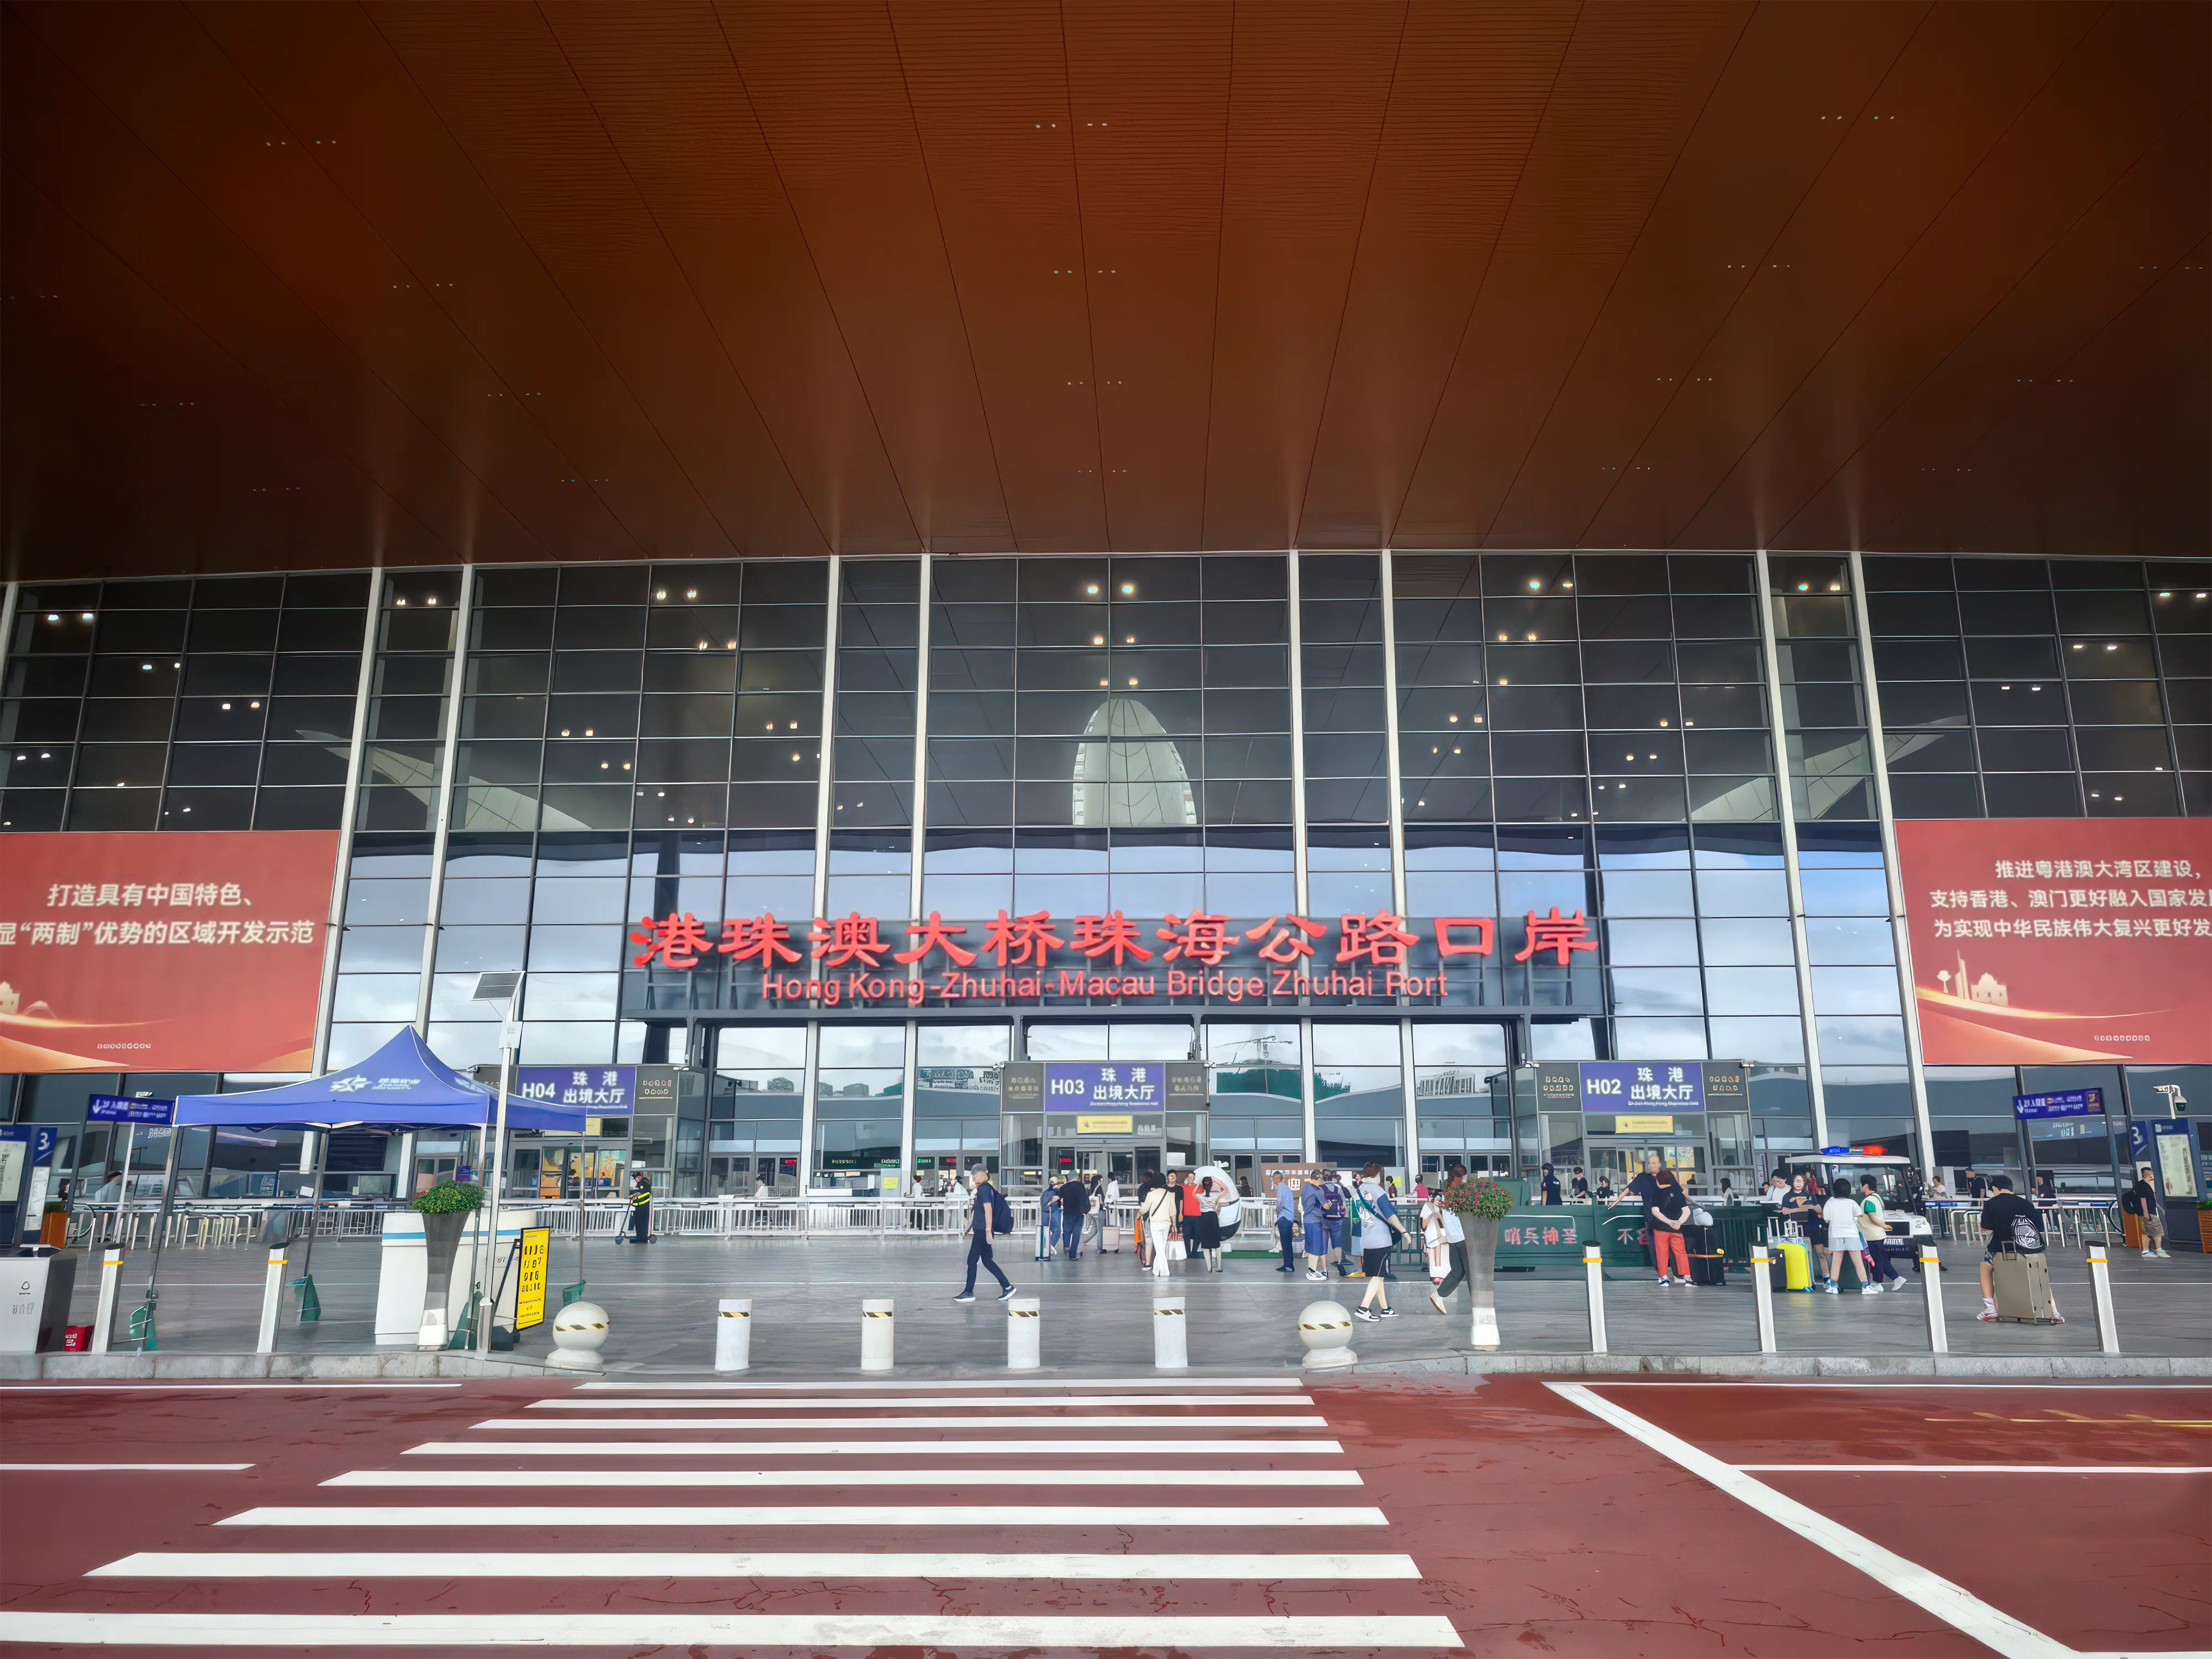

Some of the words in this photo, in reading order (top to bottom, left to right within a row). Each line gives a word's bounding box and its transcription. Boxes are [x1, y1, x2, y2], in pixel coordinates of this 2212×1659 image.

[48, 883, 252, 907] 打造具有中国特色、
[1929, 889, 2212, 908] 支持香港、澳门更好融入国家发
[629, 907, 1598, 968] 港珠澳大桥珠海公路口岸
[762, 973, 840, 1005] Hong
[1168, 970, 1264, 1001] Bridge
[1272, 970, 1372, 996] Zhuhai
[1386, 971, 1447, 996] Port
[522, 1083, 556, 1098] H04
[1051, 1079, 1084, 1094] H03
[1093, 1084, 1155, 1100] 出境大厅
[1587, 1079, 1621, 1094] H02
